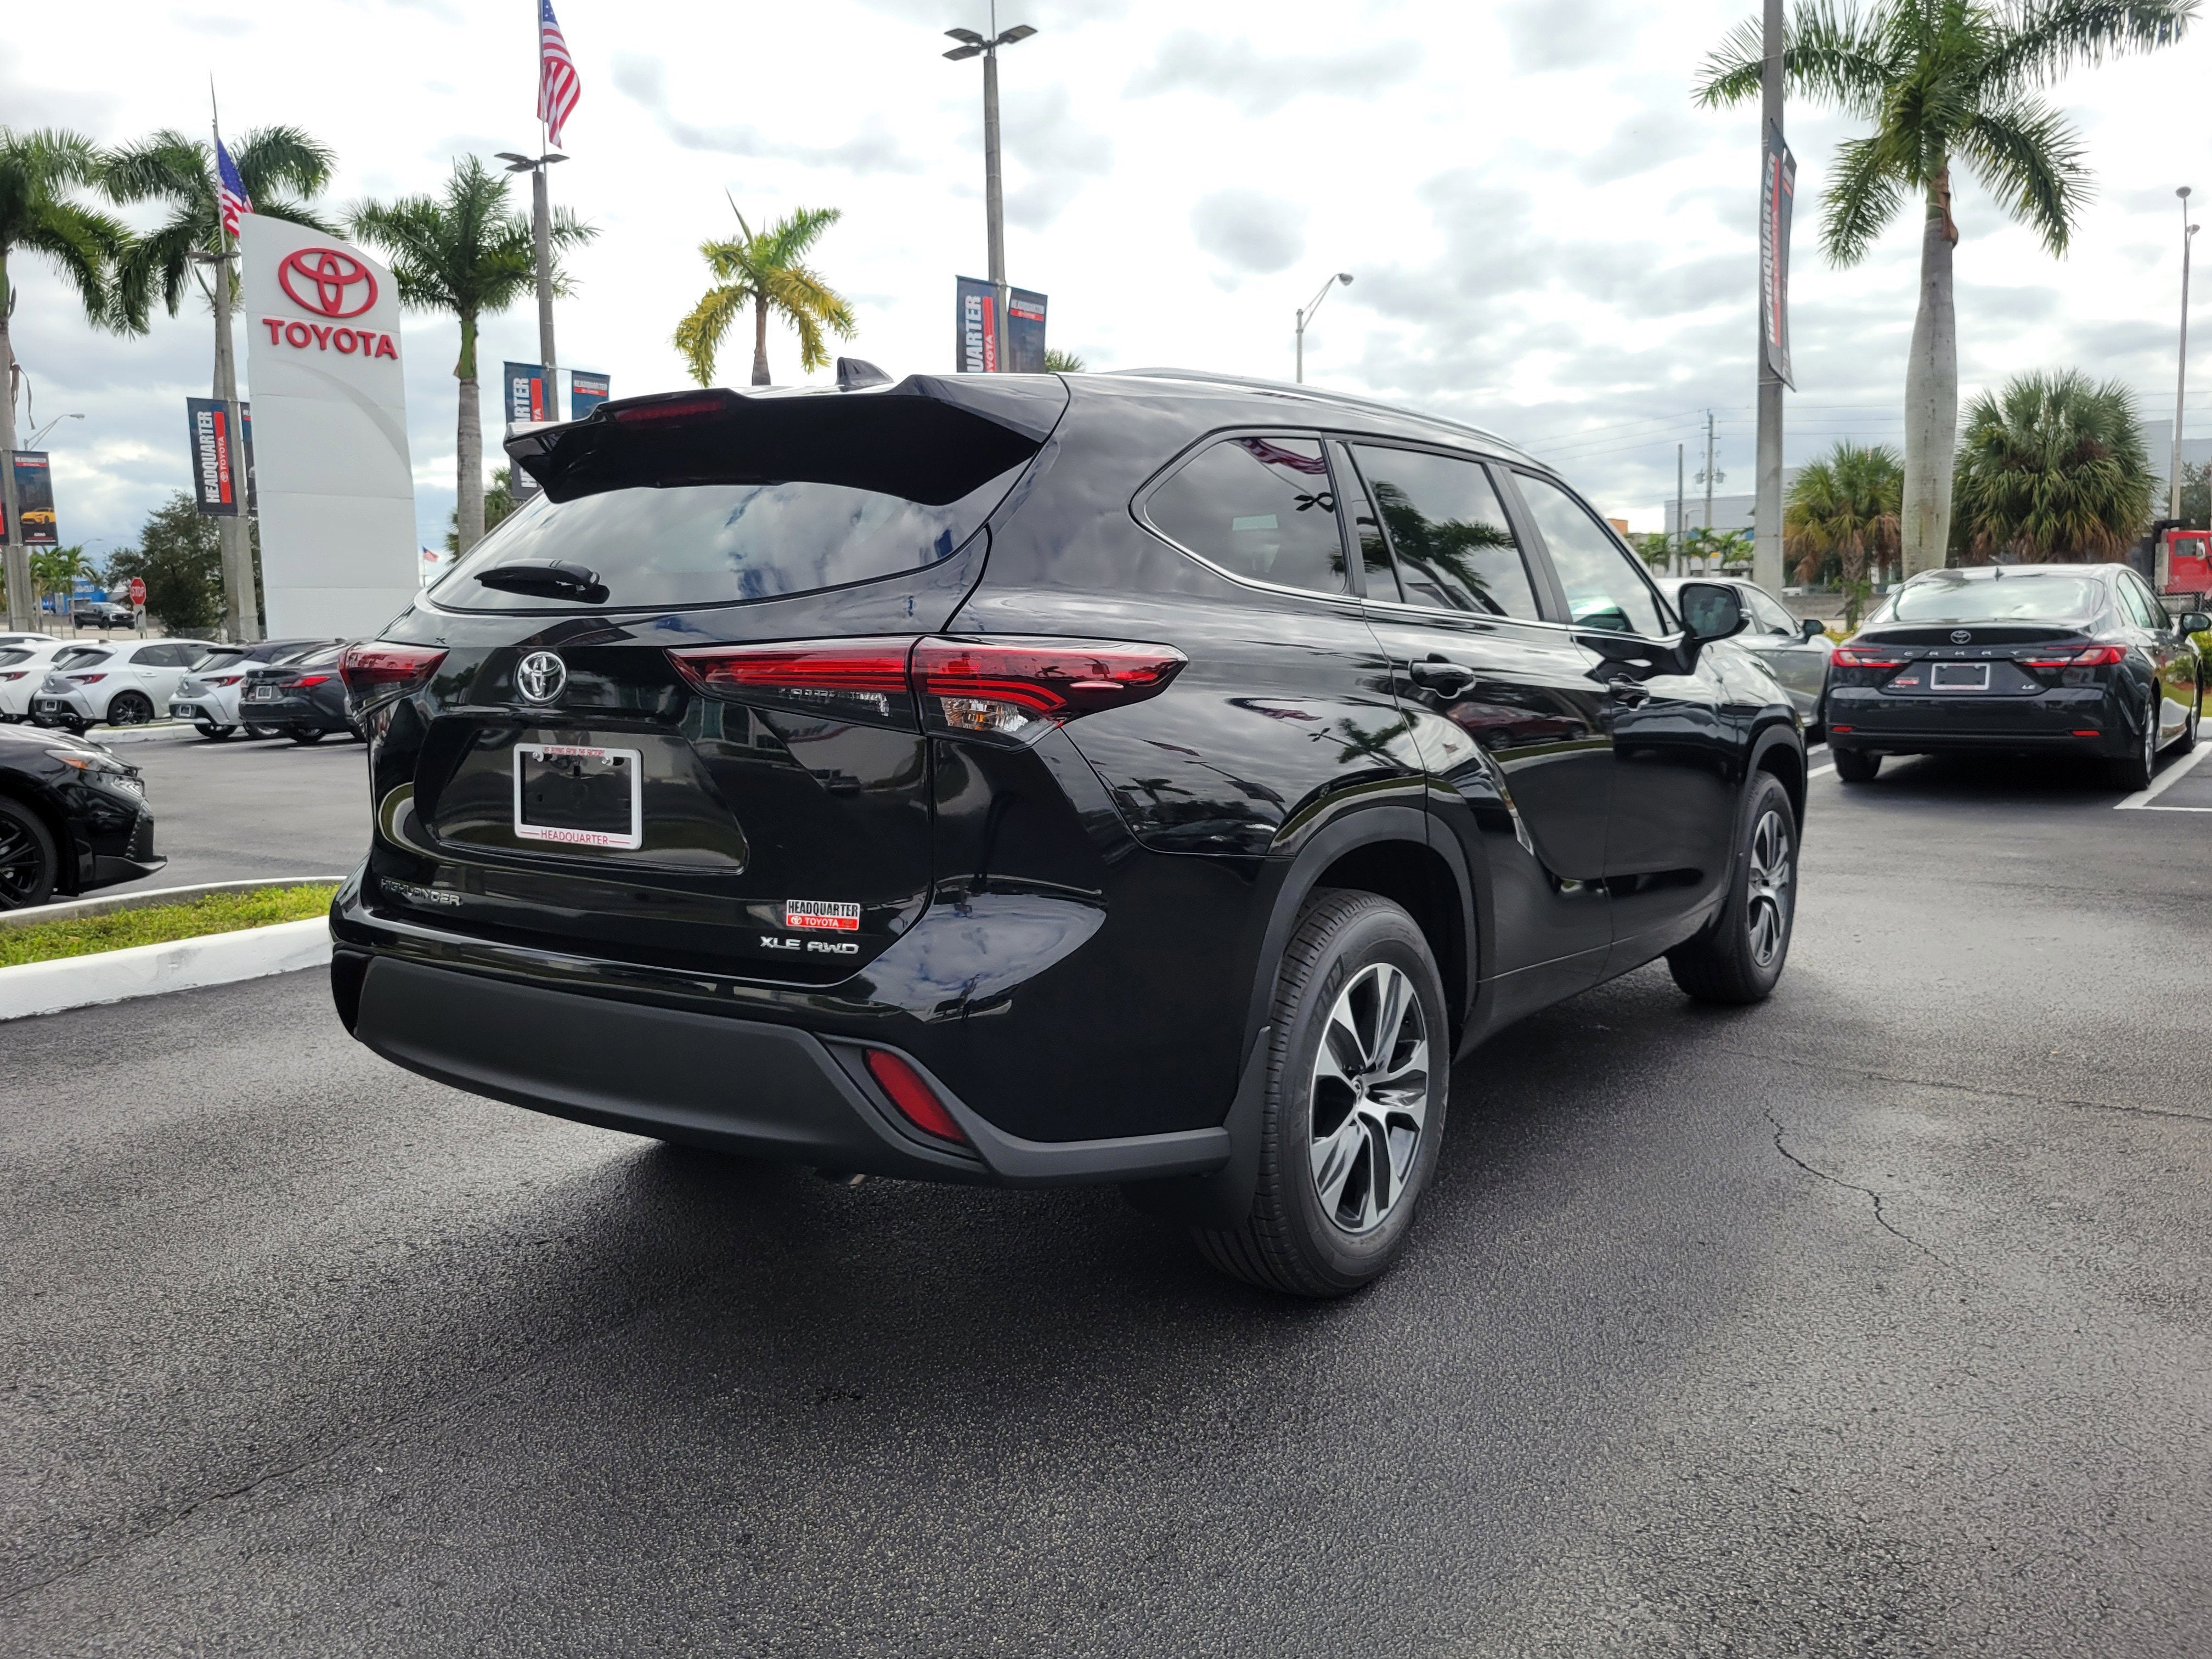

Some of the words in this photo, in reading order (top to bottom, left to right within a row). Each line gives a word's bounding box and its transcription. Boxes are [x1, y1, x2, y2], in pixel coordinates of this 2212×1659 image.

[262, 318, 398, 360] TOYOTA
[965, 295, 984, 372] UARTER
[197, 411, 221, 504] HEADQUARTER
[217, 437, 227, 470] TOYOTA
[131, 586, 145, 596] STOP
[541, 830, 608, 845] HEADQUARTER
[380, 878, 461, 906] HIGHLANDER
[788, 901, 859, 917] HEADQUARTER
[805, 917, 839, 927] TOYOTA
[760, 936, 801, 950] XLE
[807, 941, 860, 955] AWD
